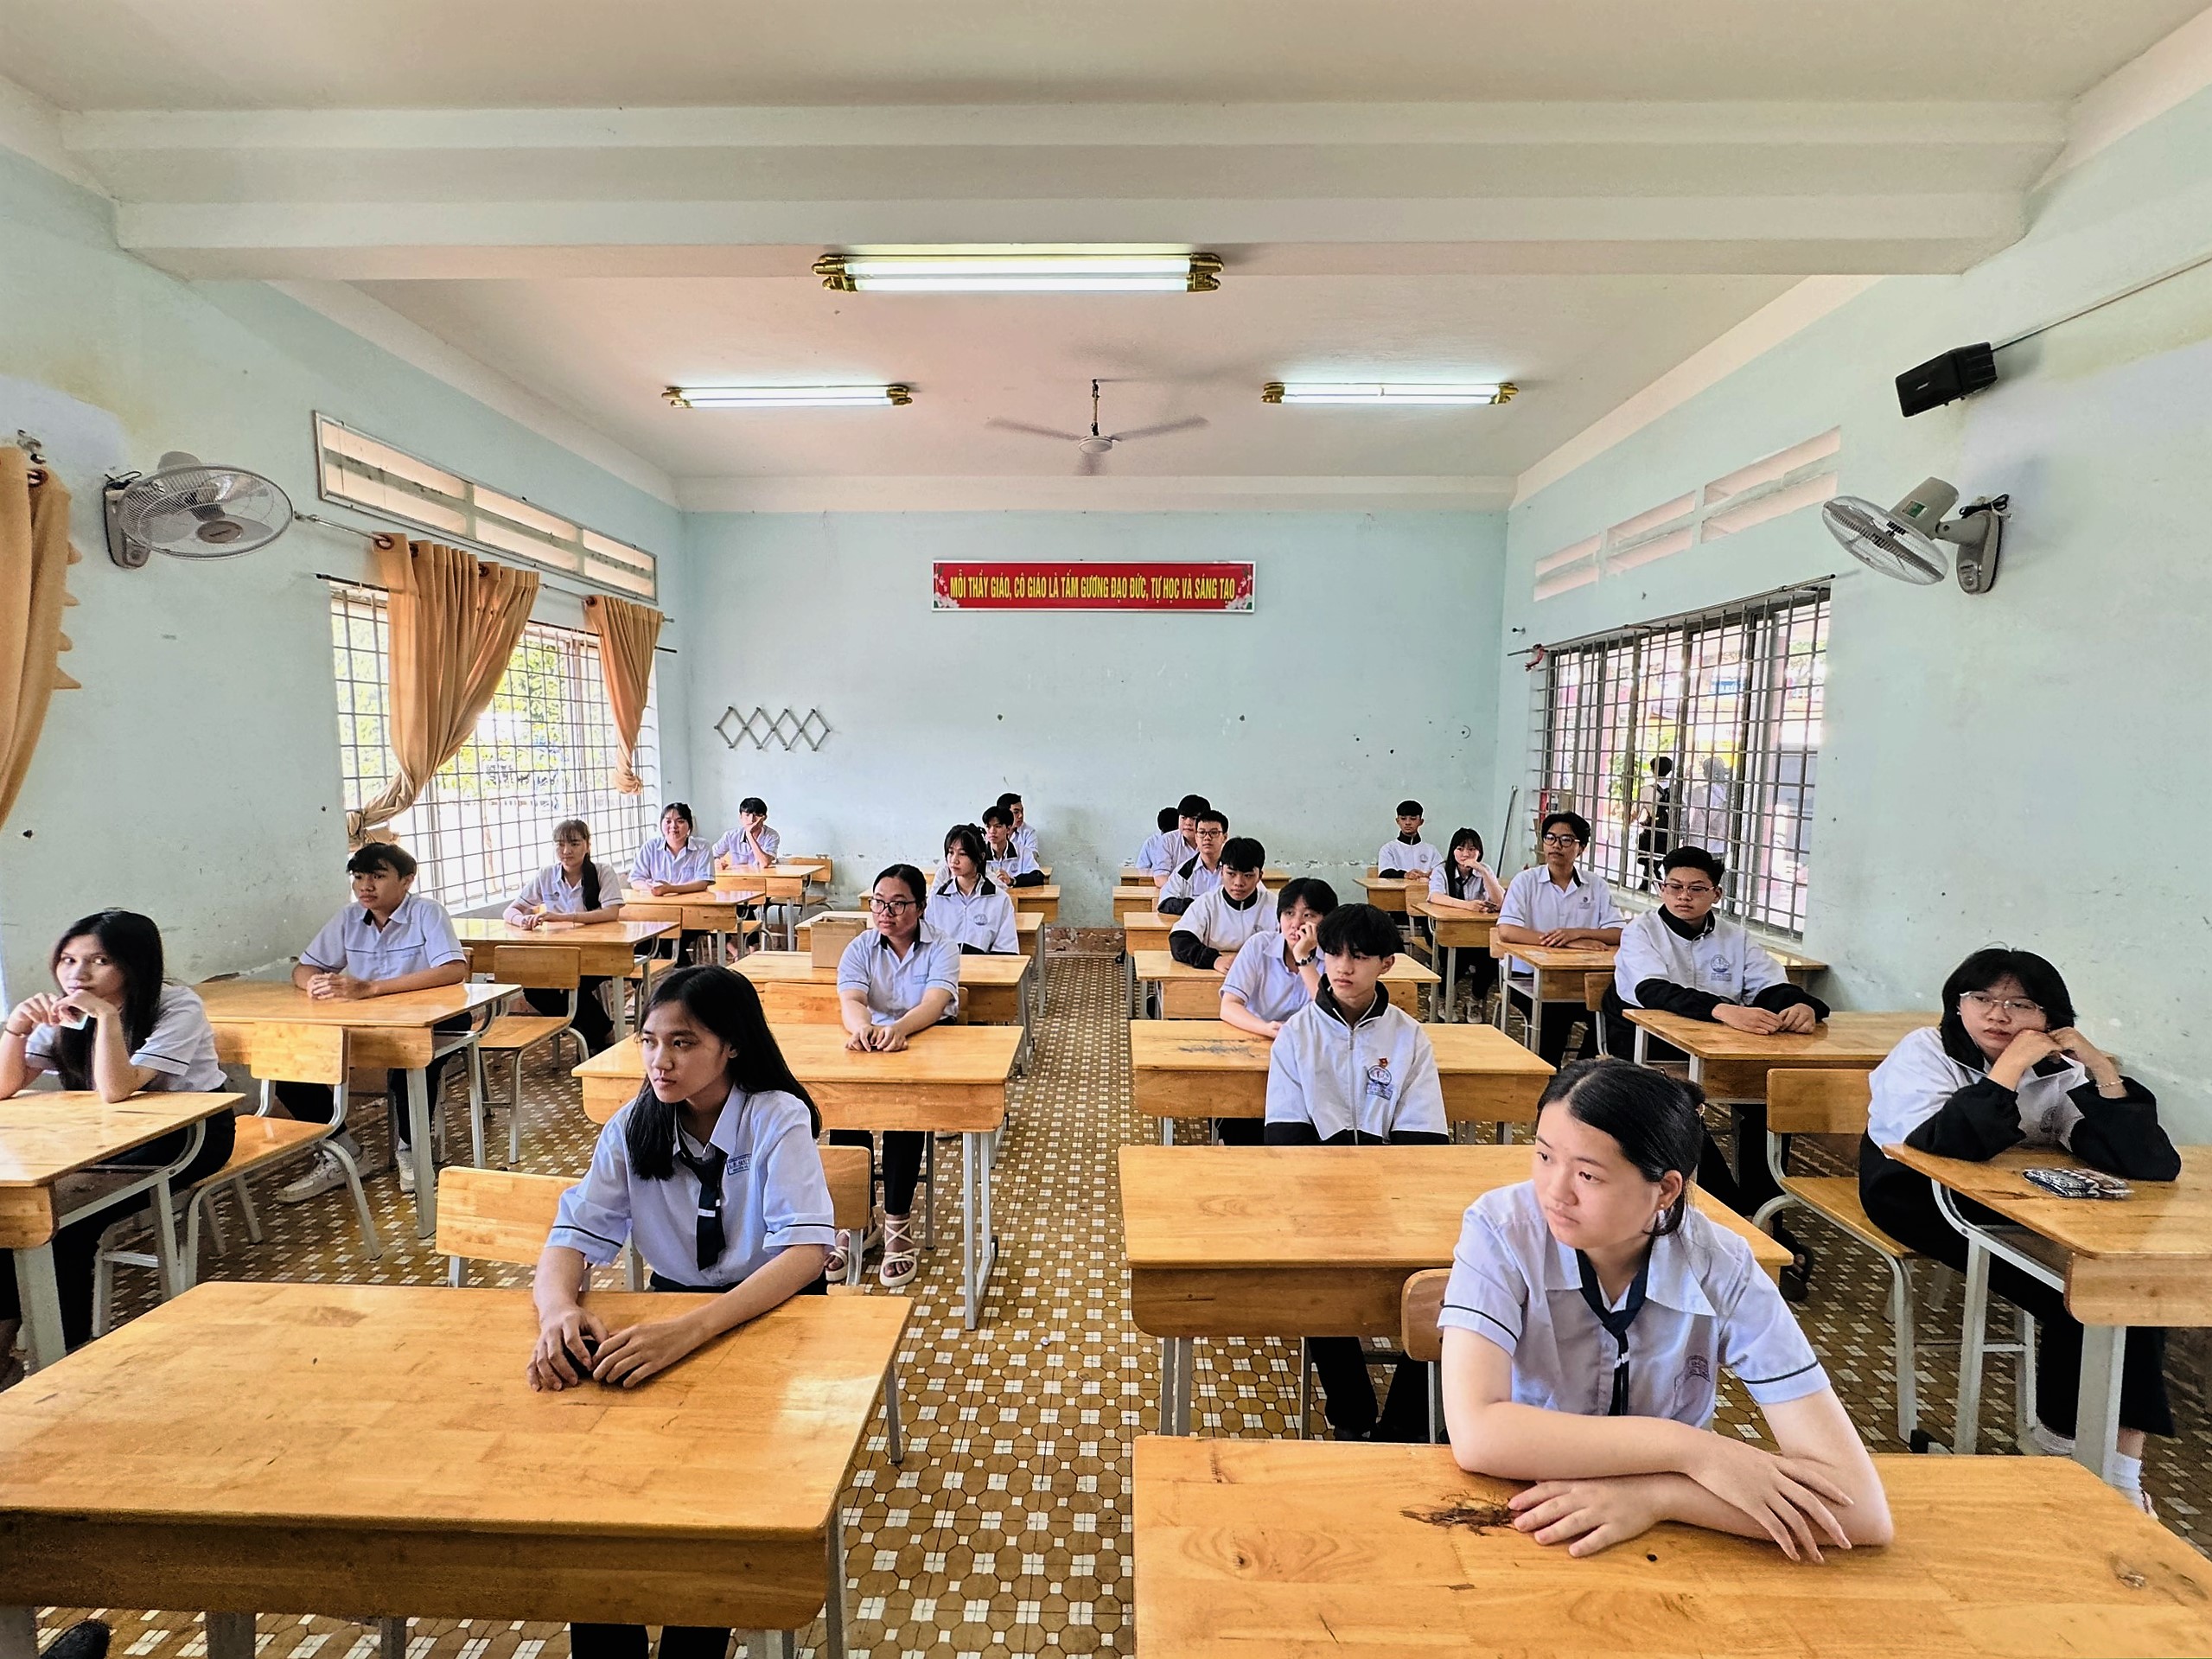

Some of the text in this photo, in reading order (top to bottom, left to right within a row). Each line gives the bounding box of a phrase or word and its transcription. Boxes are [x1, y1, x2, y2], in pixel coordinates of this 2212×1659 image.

[950, 568, 1235, 604] MỖI THẦY GIÁO, CÔ GIÁO LÀ TẤM GƯƠNG ĐẠO ĐỨC, TỰ HỌC VÀ SÁNG TẠO
